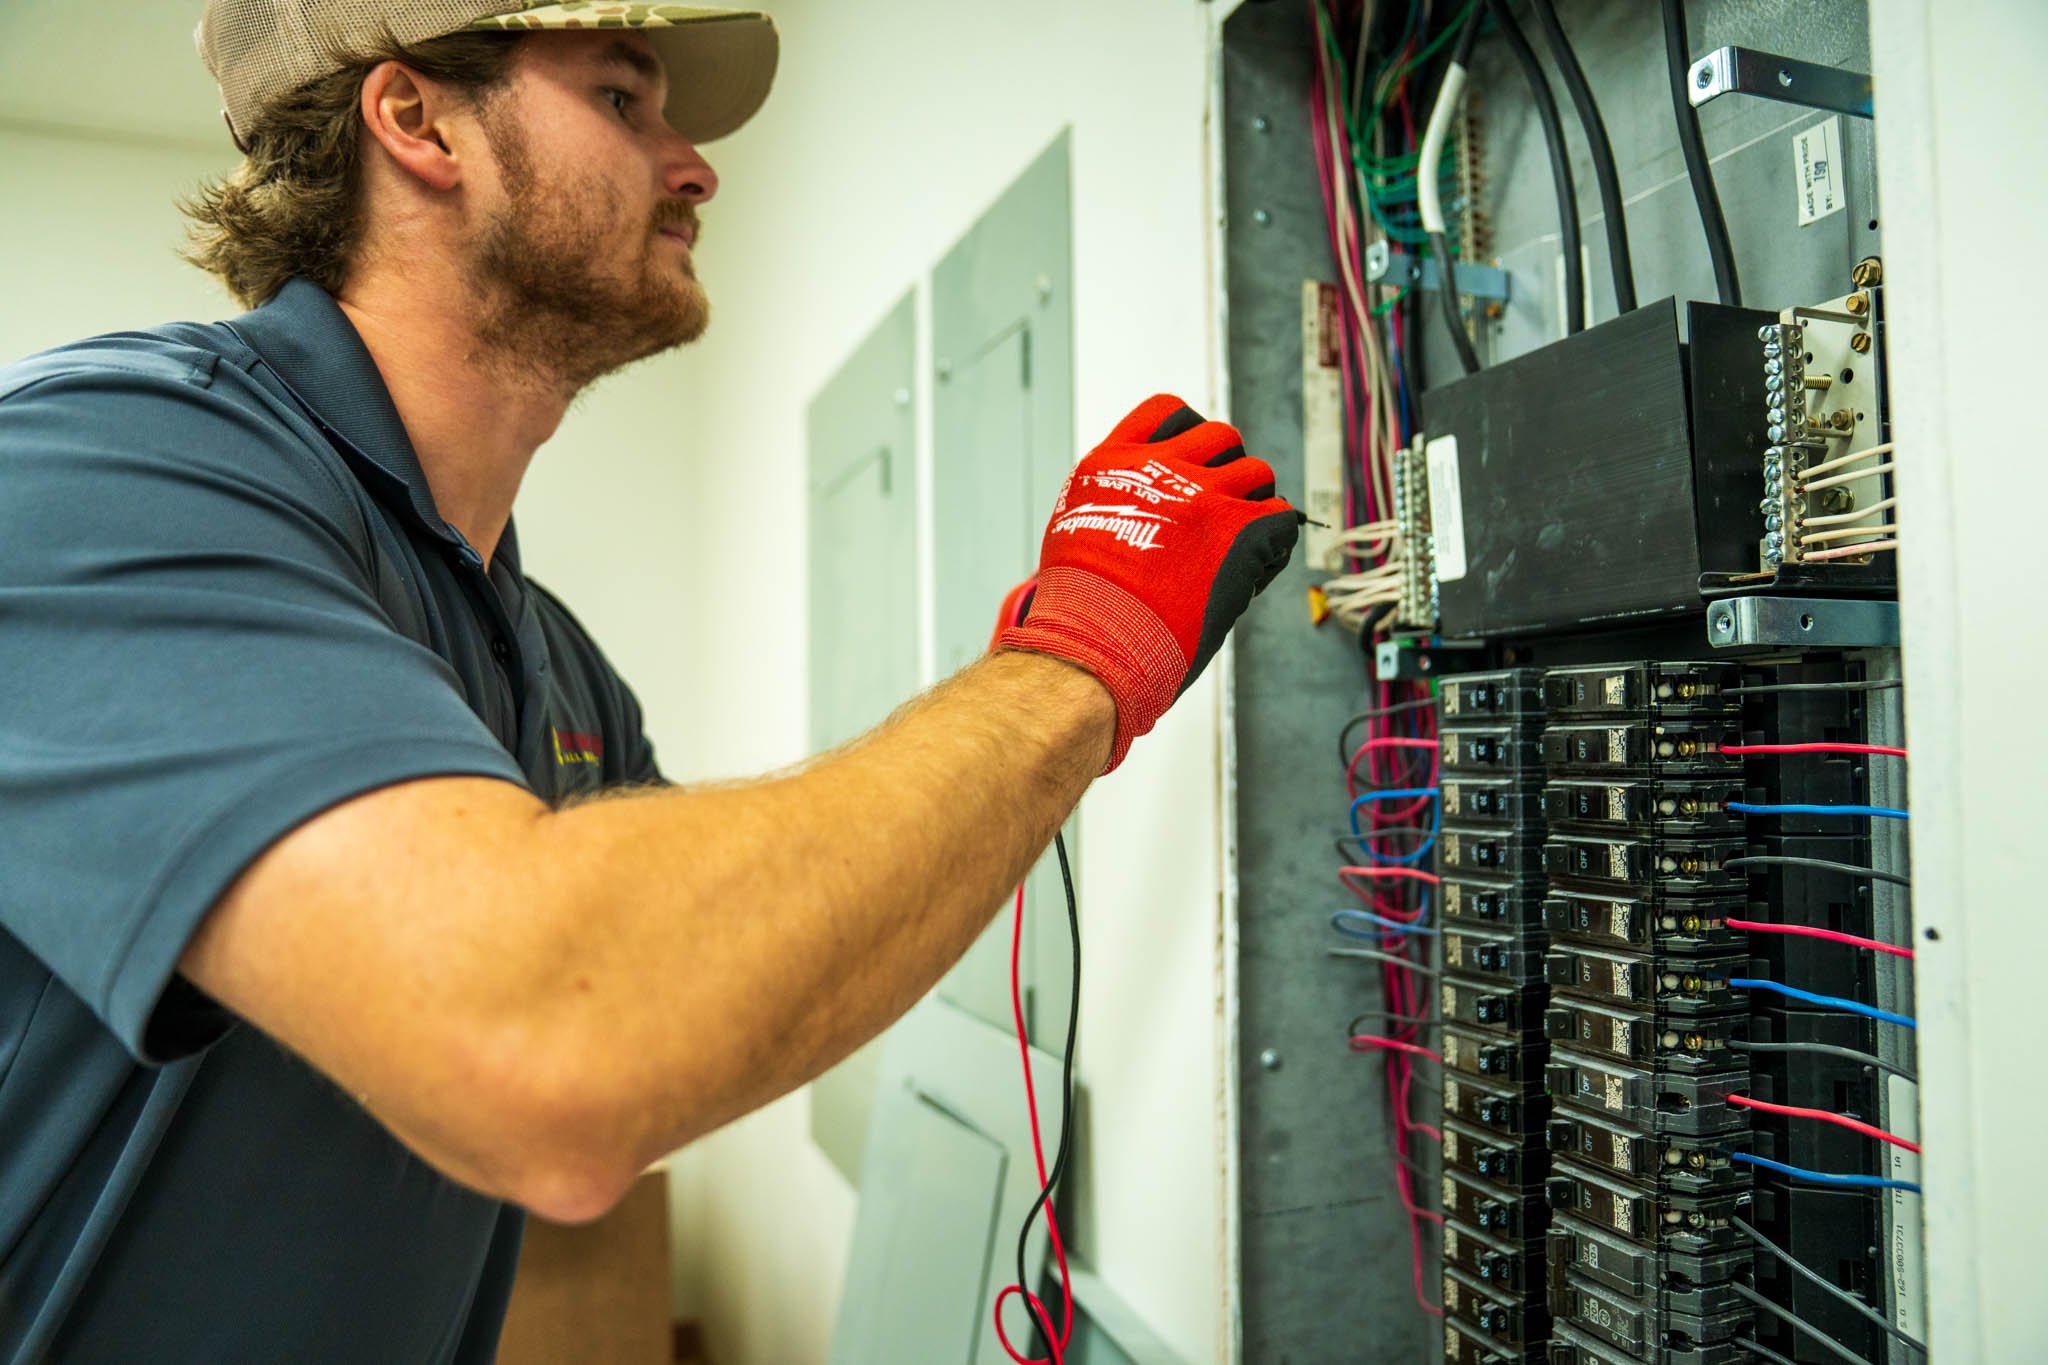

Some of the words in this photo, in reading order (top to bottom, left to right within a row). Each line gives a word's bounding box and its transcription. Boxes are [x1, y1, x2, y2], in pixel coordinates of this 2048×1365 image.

[1096, 477, 1132, 493] LEVEL
[1134, 489, 1161, 504] CUT
[1055, 515, 1165, 551] Milwaukee
[1577, 680, 1585, 700] OFF
[1580, 793, 1588, 813] OFF
[1580, 848, 1588, 869] OFF
[1581, 906, 1589, 927] OFF
[1583, 961, 1591, 982] OFF
[1479, 1006, 1487, 1018] 20
[1583, 1018, 1592, 1039] OFF
[1479, 1057, 1488, 1070] 20
[1482, 1109, 1490, 1121] 20
[1585, 1130, 1593, 1152] OFF
[1479, 1160, 1488, 1173] 20
[1584, 1188, 1592, 1209] OFF
[1480, 1213, 1488, 1226] 20
[1481, 1265, 1489, 1278] 20
[1480, 1316, 1489, 1328] 20
